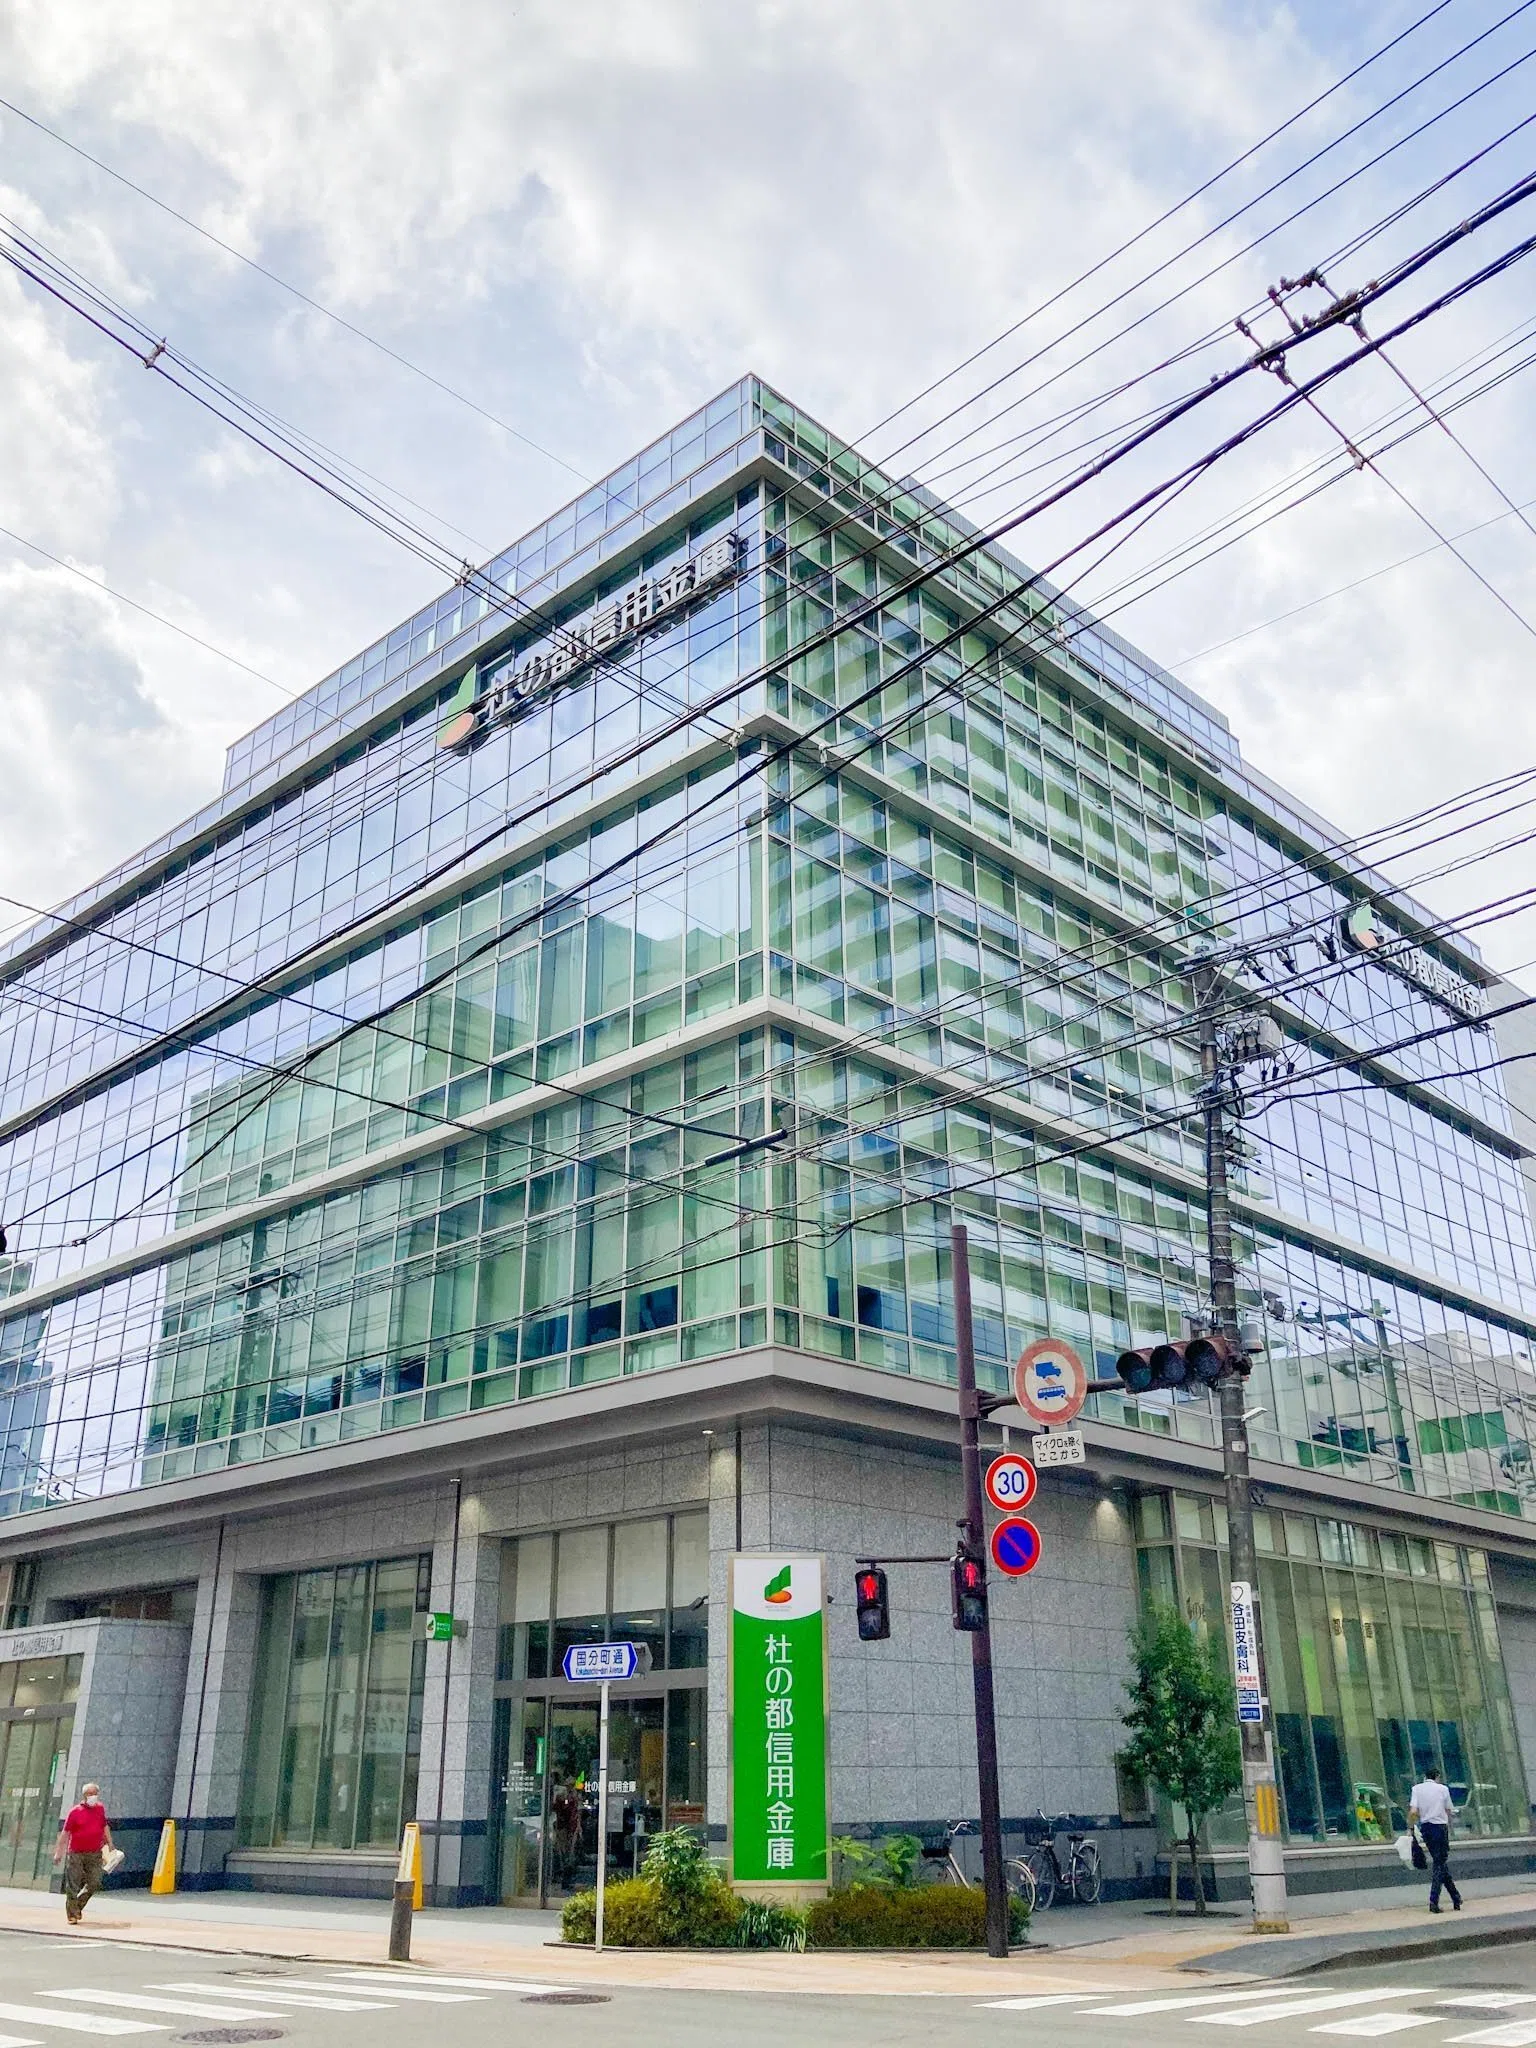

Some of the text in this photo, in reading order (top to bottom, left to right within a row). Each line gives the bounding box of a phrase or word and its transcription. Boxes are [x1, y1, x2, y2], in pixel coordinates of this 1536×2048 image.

[1035, 1436, 1080, 1450] マイクロを除く
[1039, 1449, 1080, 1462] ここから
[997, 1470, 1025, 1496] 30
[576, 1648, 623, 1666] 国分町通
[763, 1633, 795, 1870] 杜の都信用金庫
[584, 1780, 637, 1793] 杜の信用金庫
